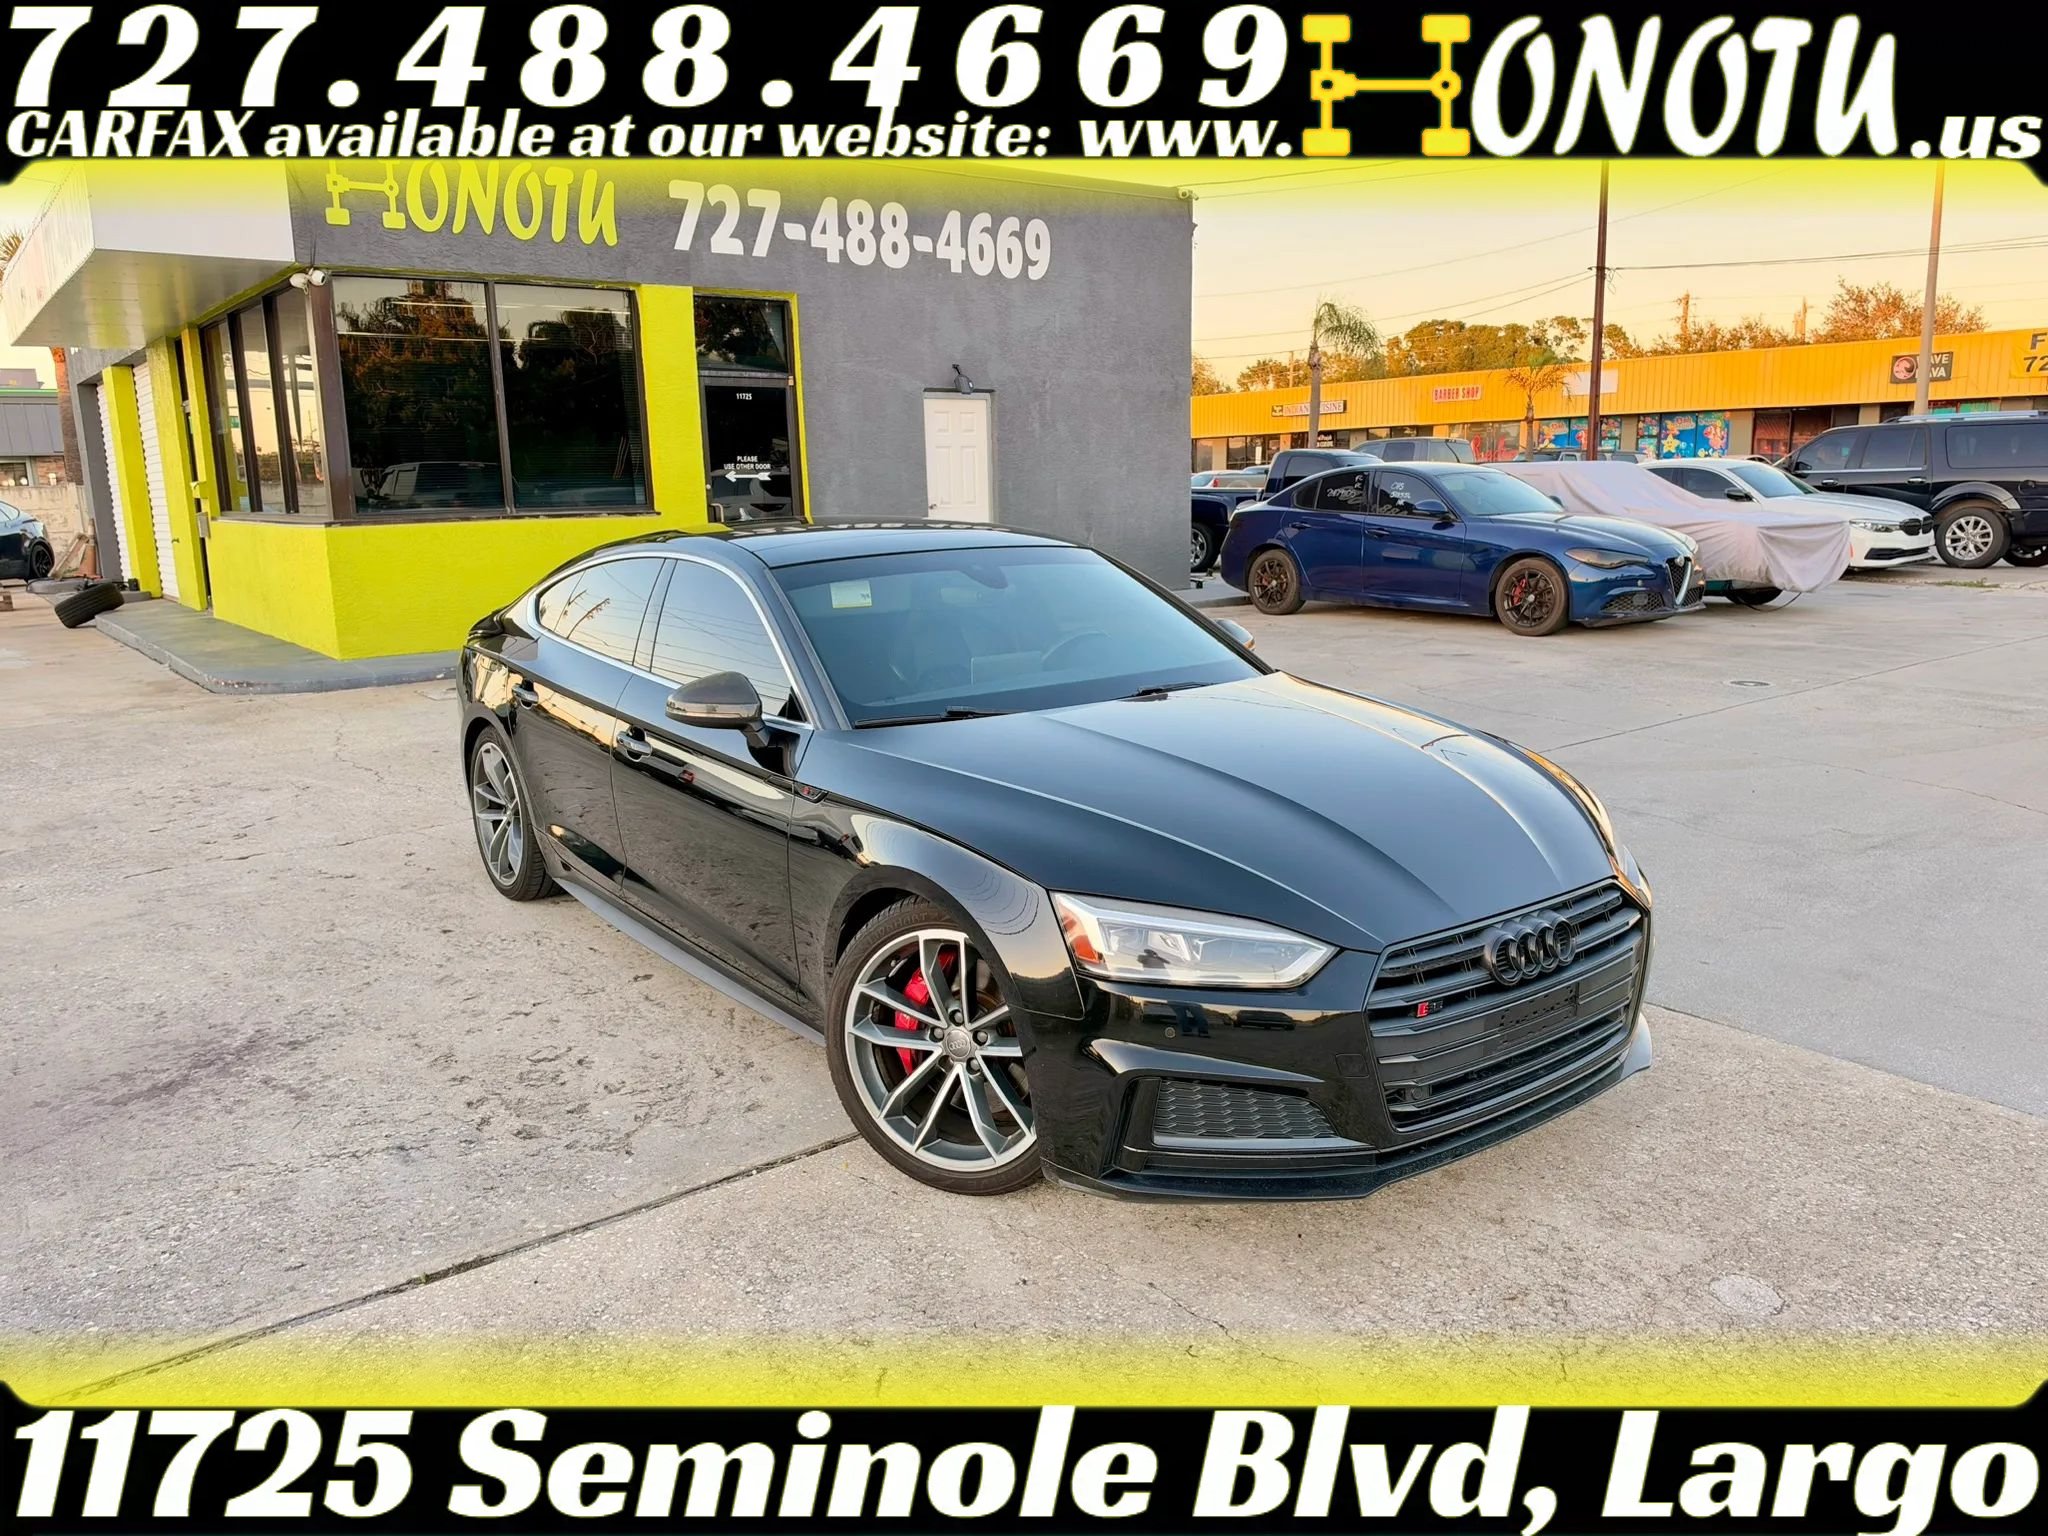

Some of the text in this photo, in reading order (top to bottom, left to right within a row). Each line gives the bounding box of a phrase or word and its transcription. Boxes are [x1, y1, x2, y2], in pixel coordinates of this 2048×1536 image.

[668, 179, 1051, 281] 727-488-4669
[736, 392, 753, 400] 11725
[1434, 386, 1480, 401] BARBER SHOP
[736, 455, 758, 463] PLEASE
[735, 463, 755, 471] OTHER
